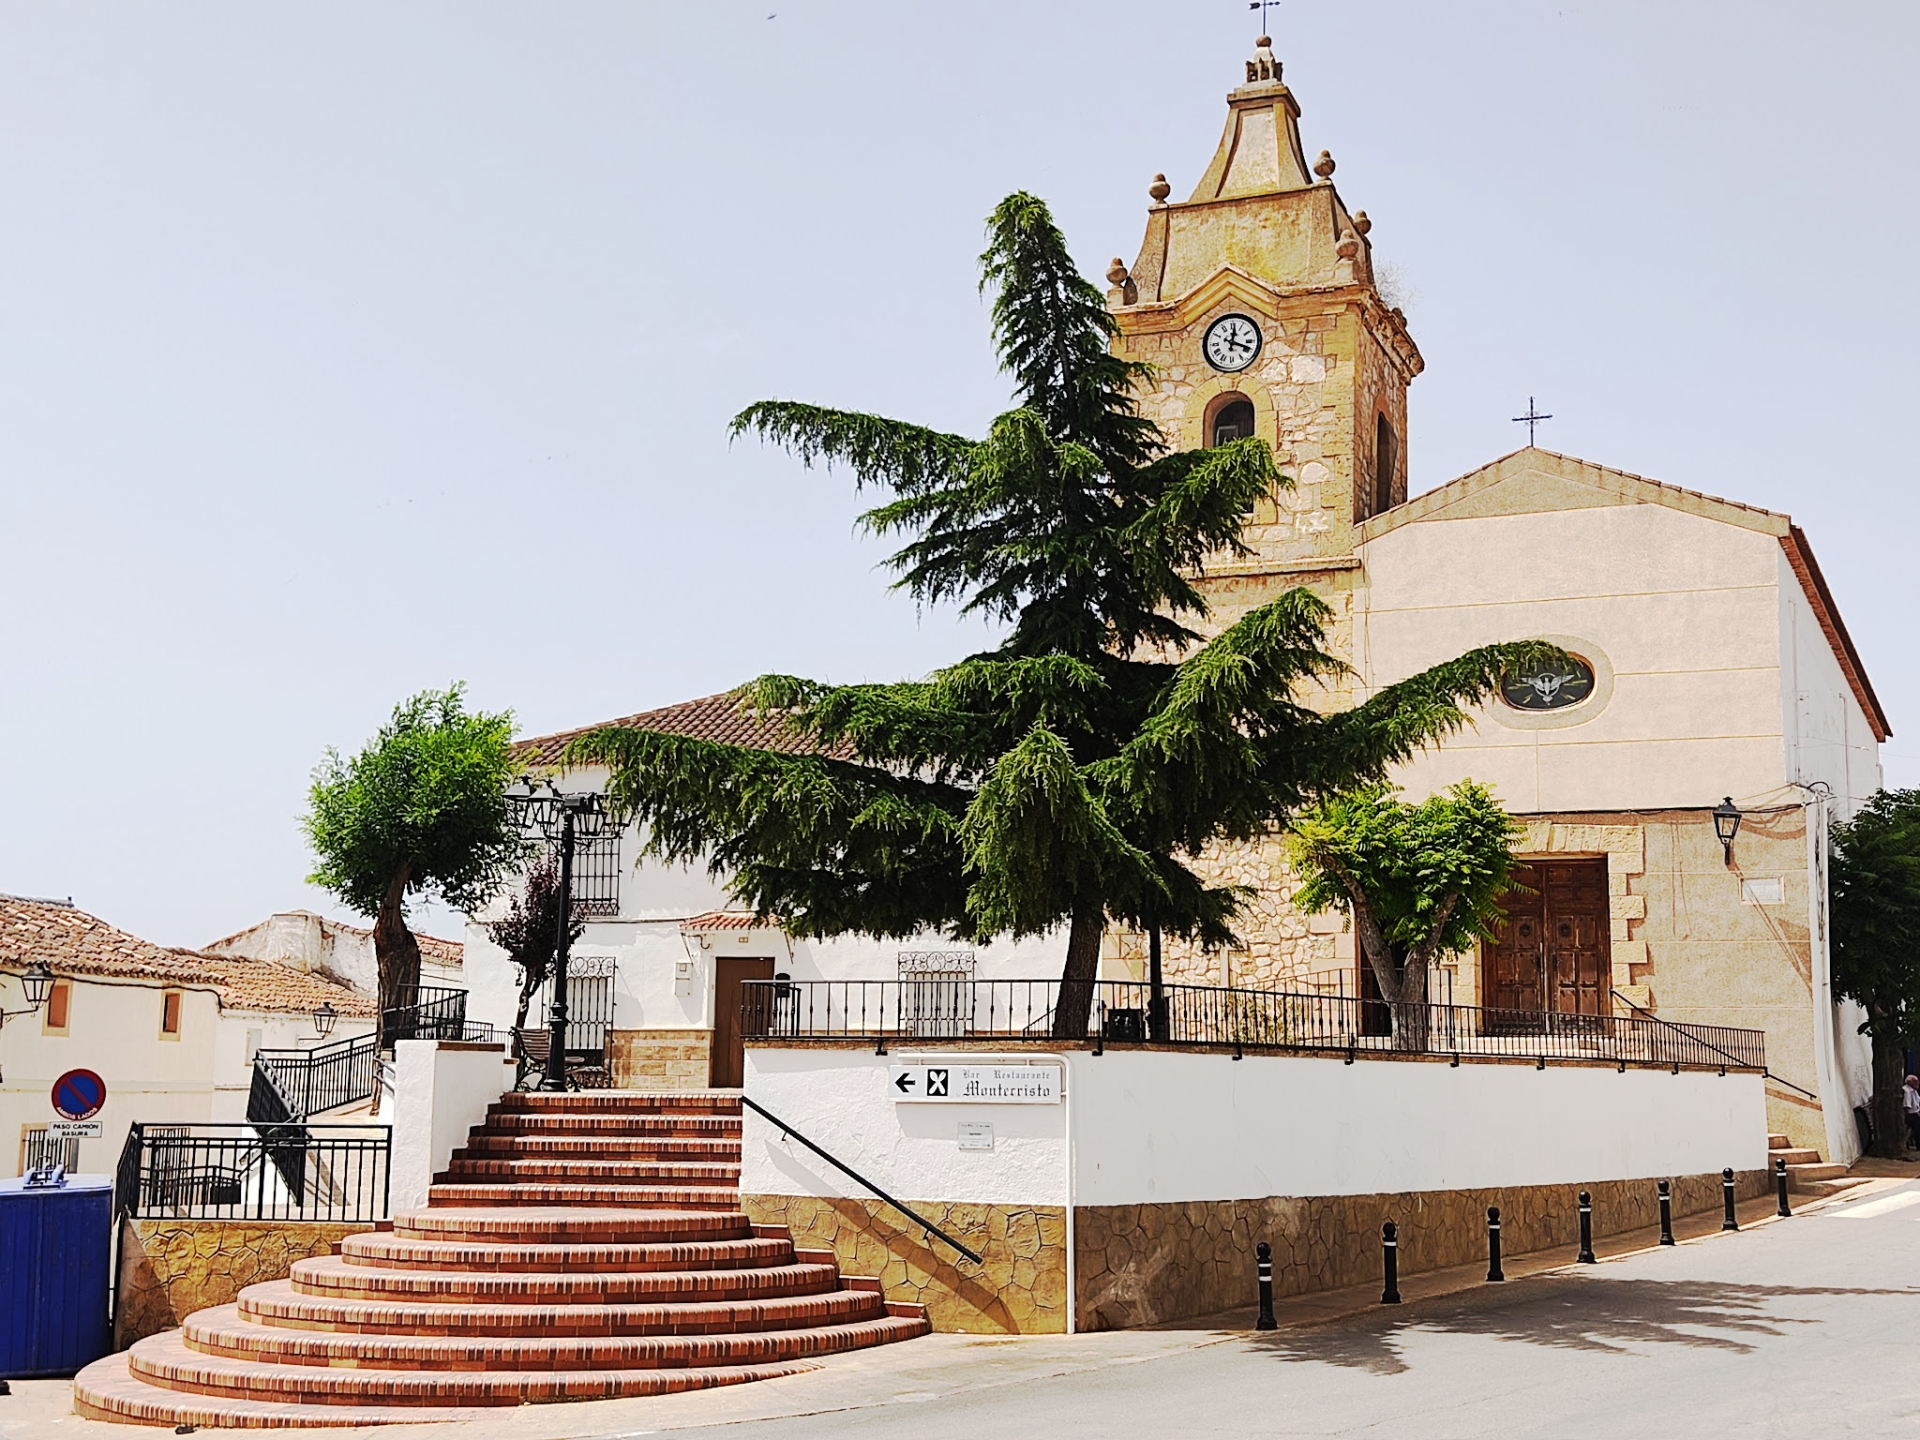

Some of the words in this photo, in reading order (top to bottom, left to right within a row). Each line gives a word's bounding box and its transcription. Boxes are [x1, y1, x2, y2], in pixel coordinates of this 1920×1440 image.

[963, 1070, 980, 1079] Bar
[994, 1070, 1050, 1079] Restaurante
[963, 1081, 1050, 1097] Montecristo
